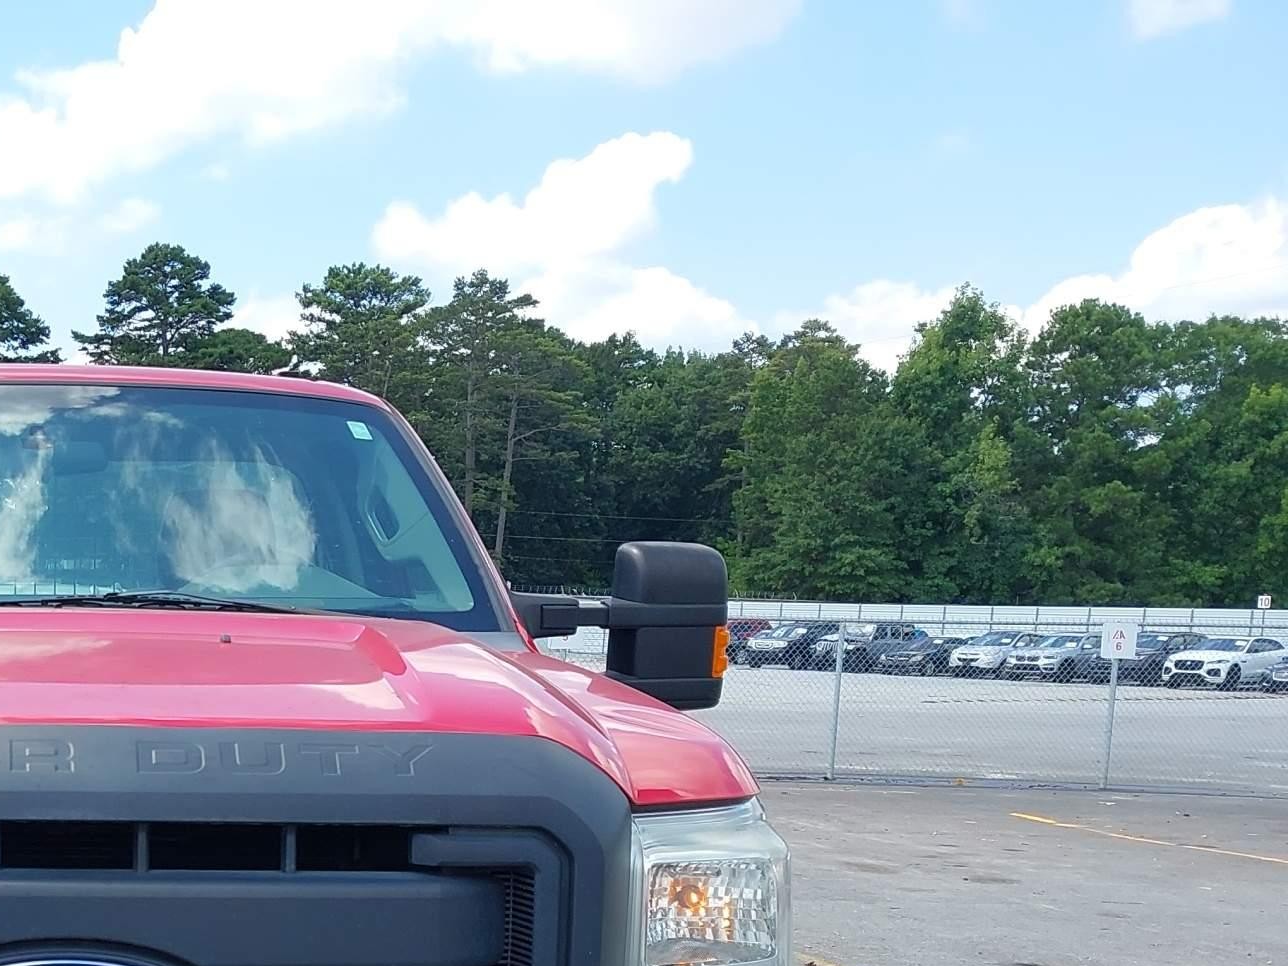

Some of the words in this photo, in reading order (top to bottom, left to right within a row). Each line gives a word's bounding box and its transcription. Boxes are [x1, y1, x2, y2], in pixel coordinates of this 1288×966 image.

[1260, 597, 1270, 607] 10
[1115, 641, 1123, 651] 6
[136, 740, 434, 777] DUTY
